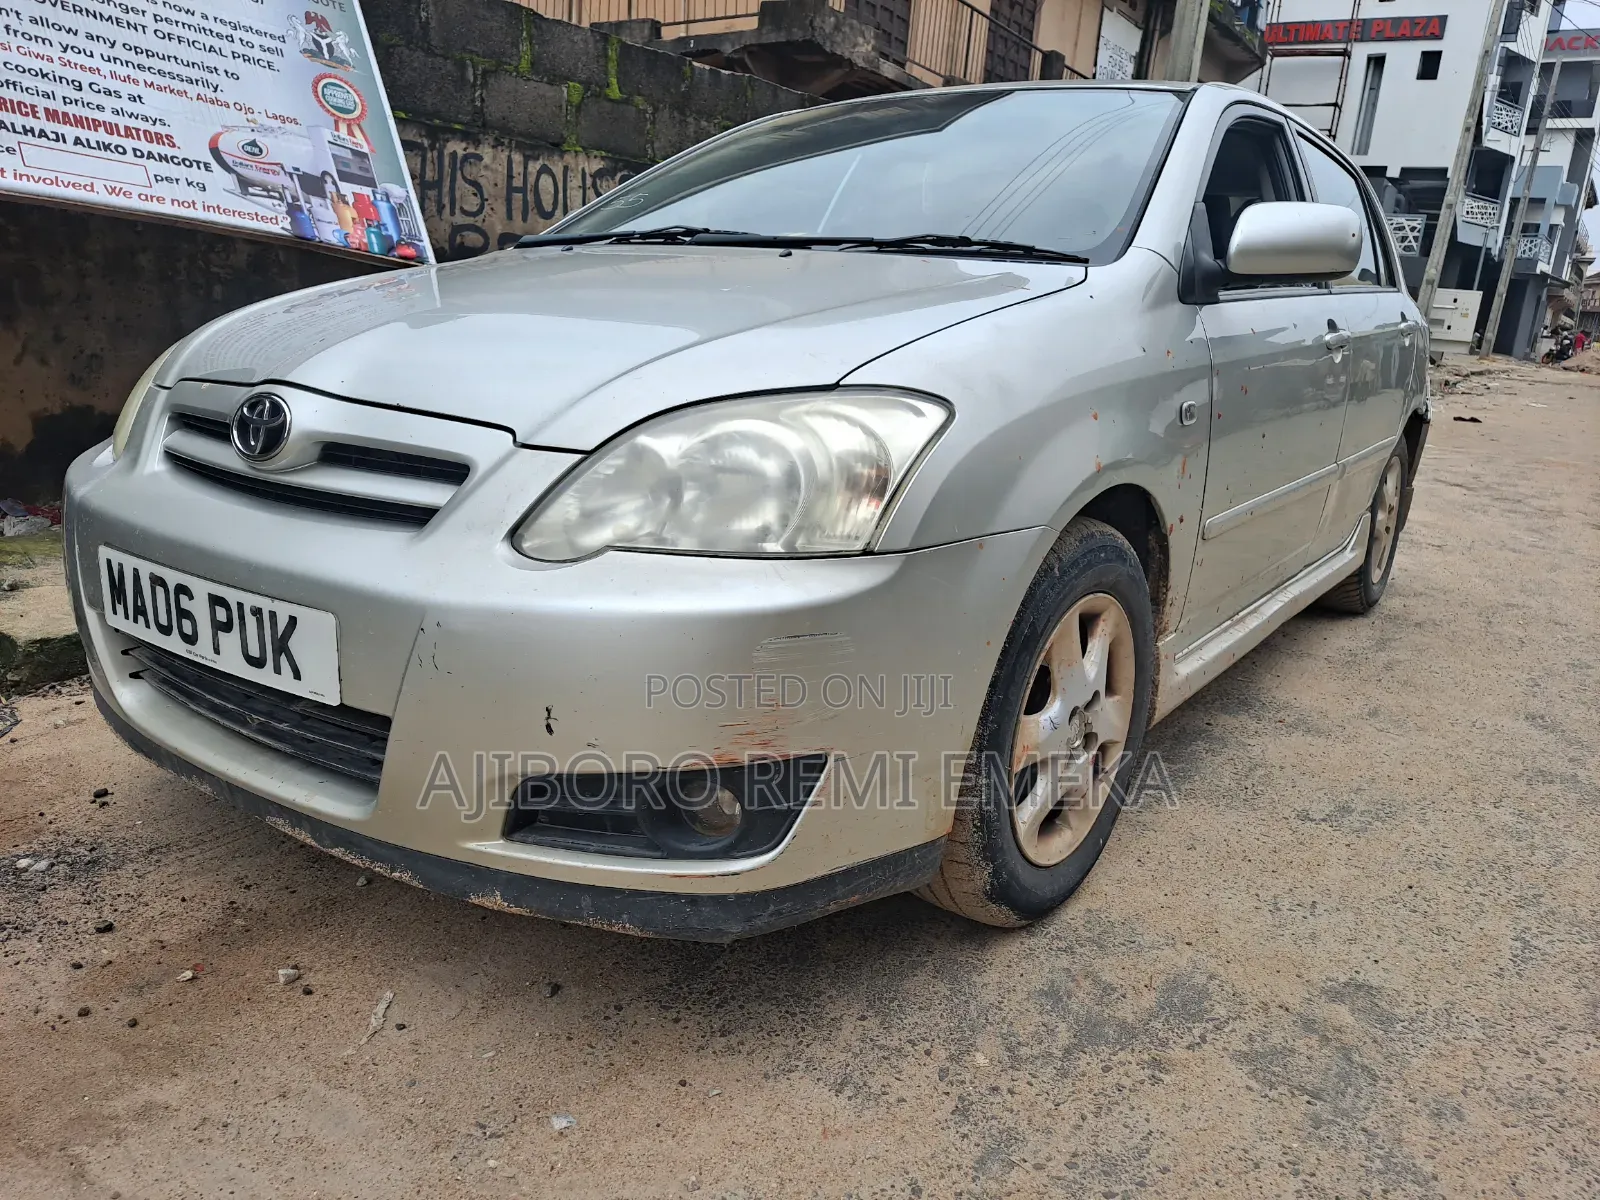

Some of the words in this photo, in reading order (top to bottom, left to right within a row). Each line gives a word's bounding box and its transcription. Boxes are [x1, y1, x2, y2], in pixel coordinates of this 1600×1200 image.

[153, 13, 235, 43] permitted
[239, 37, 255, 49] to
[259, 44, 284, 58] sell
[162, 0, 196, 16] now
[201, 12, 209, 21] a
[213, 15, 286, 44] registered
[1264, 21, 1362, 43] ULTIMATE
[1370, 17, 1441, 39] PLAZA
[4, 24, 53, 47] from
[58, 41, 94, 59] you
[100, 52, 223, 93] unnecessarily.
[28, 15, 78, 36] allow
[85, 31, 116, 49] any
[122, 42, 221, 76] oppurtunist
[224, 69, 240, 81] to
[153, 29, 228, 58] OFFICIAL
[231, 50, 280, 72] PRICE.
[0, 41, 12, 52] si
[16, 45, 54, 64] Giwa
[58, 56, 107, 79] Street,
[109, 70, 140, 87] Ilufe
[144, 79, 193, 101] Market,
[196, 93, 230, 109] Alaba
[234, 102, 255, 115] Ojo
[265, 109, 302, 126] Lagos.
[3, 61, 83, 92] cooking
[88, 82, 122, 99] Gas
[128, 93, 145, 105] at
[43, 107, 181, 149] MANIPULATORS.
[62, 95, 105, 112] price
[111, 107, 171, 127] always.
[0, 119, 67, 144] ALHAJI
[73, 135, 128, 156] ALIKO
[132, 147, 213, 173] DANGOTE
[13, 169, 100, 195] involved,
[103, 184, 133, 199] We
[137, 193, 166, 205] are
[171, 198, 199, 211] not
[153, 173, 181, 186] per
[186, 177, 207, 192] kg
[106, 558, 199, 646] MA06
[207, 592, 302, 681] PUK
